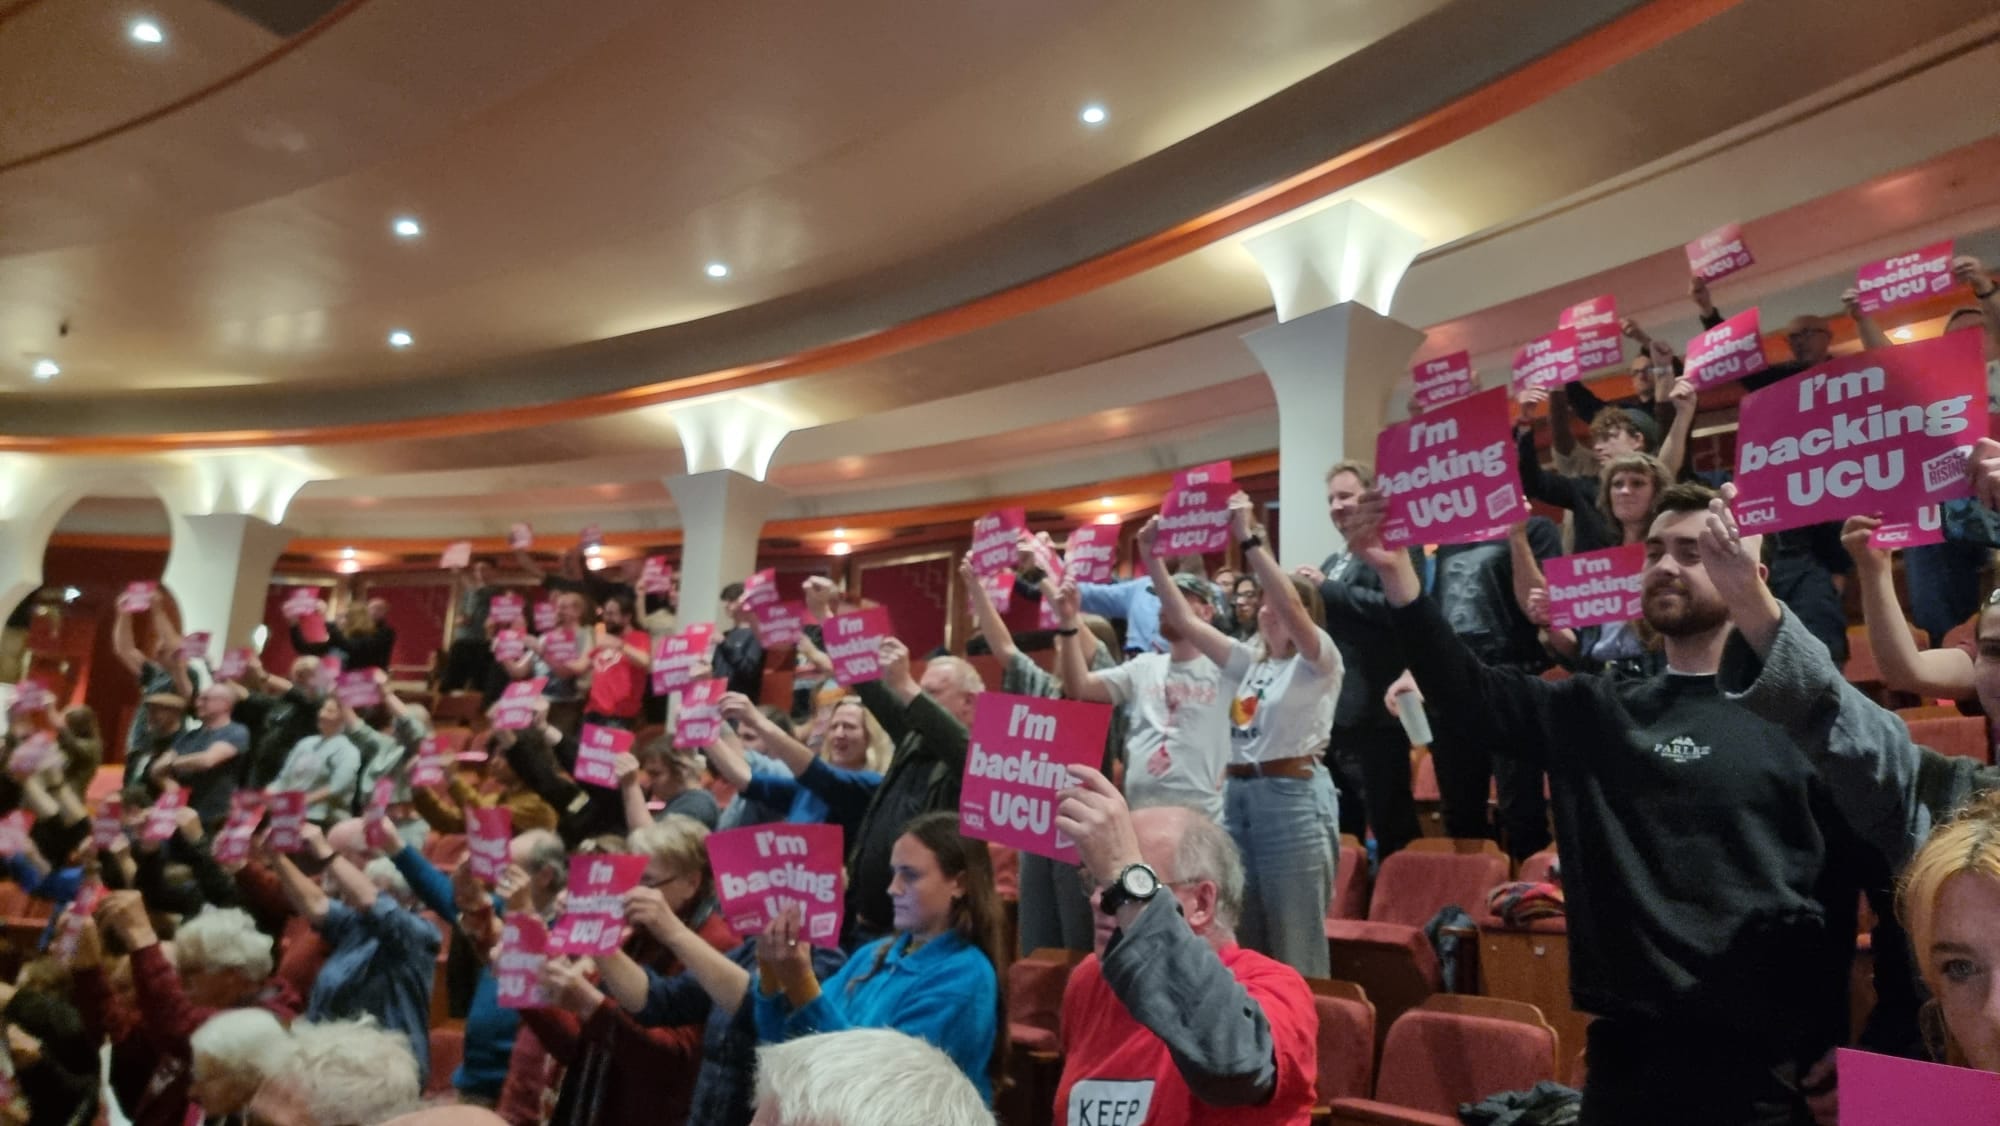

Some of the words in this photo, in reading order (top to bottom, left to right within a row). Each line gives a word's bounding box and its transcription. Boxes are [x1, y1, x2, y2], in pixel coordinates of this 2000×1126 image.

[1859, 255, 1947, 293] backing
[1881, 277, 1926, 302] UCU
[1704, 326, 1732, 347] I'm
[1580, 352, 1603, 367] CU
[1700, 355, 1740, 382] UCU
[1798, 366, 1885, 413] I'm
[1409, 418, 1458, 453] I'm
[1739, 394, 1973, 474] backing
[1377, 441, 1507, 497] backing
[1787, 449, 1904, 506] UCU
[1407, 485, 1477, 528] UCU
[1738, 507, 1775, 525] UCU
[1171, 528, 1208, 548] UCU
[1573, 557, 1611, 576] I'm
[1549, 574, 1643, 601] backing
[1573, 596, 1621, 618] UCU
[837, 617, 863, 635] I'm
[1008, 704, 1056, 741] I'm
[990, 791, 1050, 834] UCU
[754, 830, 808, 857] I'm
[1080, 1098, 1140, 1126] KEEP
